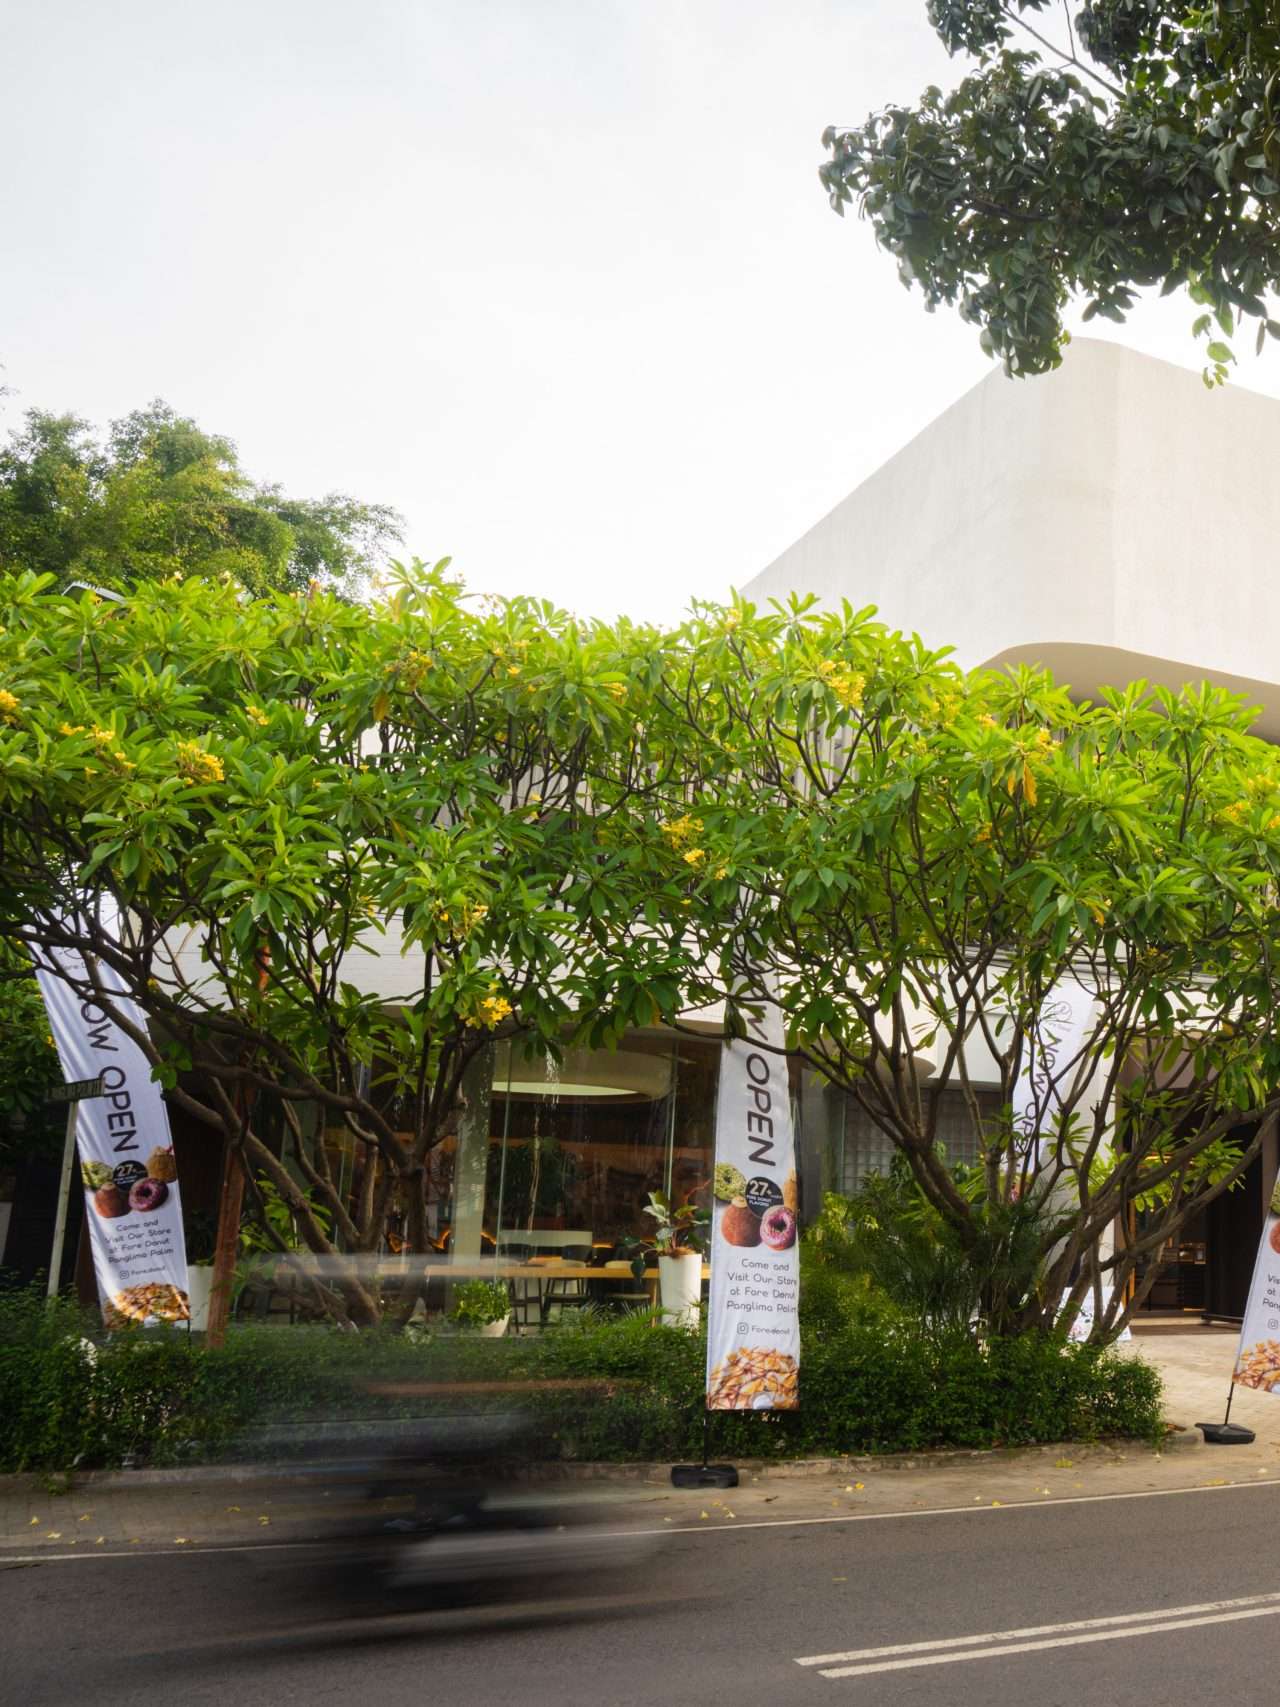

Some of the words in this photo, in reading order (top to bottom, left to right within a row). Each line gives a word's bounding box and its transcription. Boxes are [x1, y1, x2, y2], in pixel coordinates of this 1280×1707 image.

[81, 1001, 119, 1052] OW
[98, 1066, 140, 1153] OPEN
[746, 1053, 776, 1167] OPEN
[116, 1224, 139, 1232] Come
[143, 1219, 159, 1228] and
[127, 1231, 145, 1240] Our
[148, 1227, 172, 1237] Store
[121, 1241, 142, 1251] Fore
[144, 1238, 170, 1247] Donut
[741, 1258, 769, 1270] Come
[773, 1263, 789, 1271] and
[727, 1272, 750, 1282] Visit
[753, 1273, 773, 1284] Our
[730, 1287, 741, 1296] at
[744, 1287, 769, 1298] Fore
[1266, 1288, 1276, 1296] at
[726, 1300, 774, 1313] Panglima
